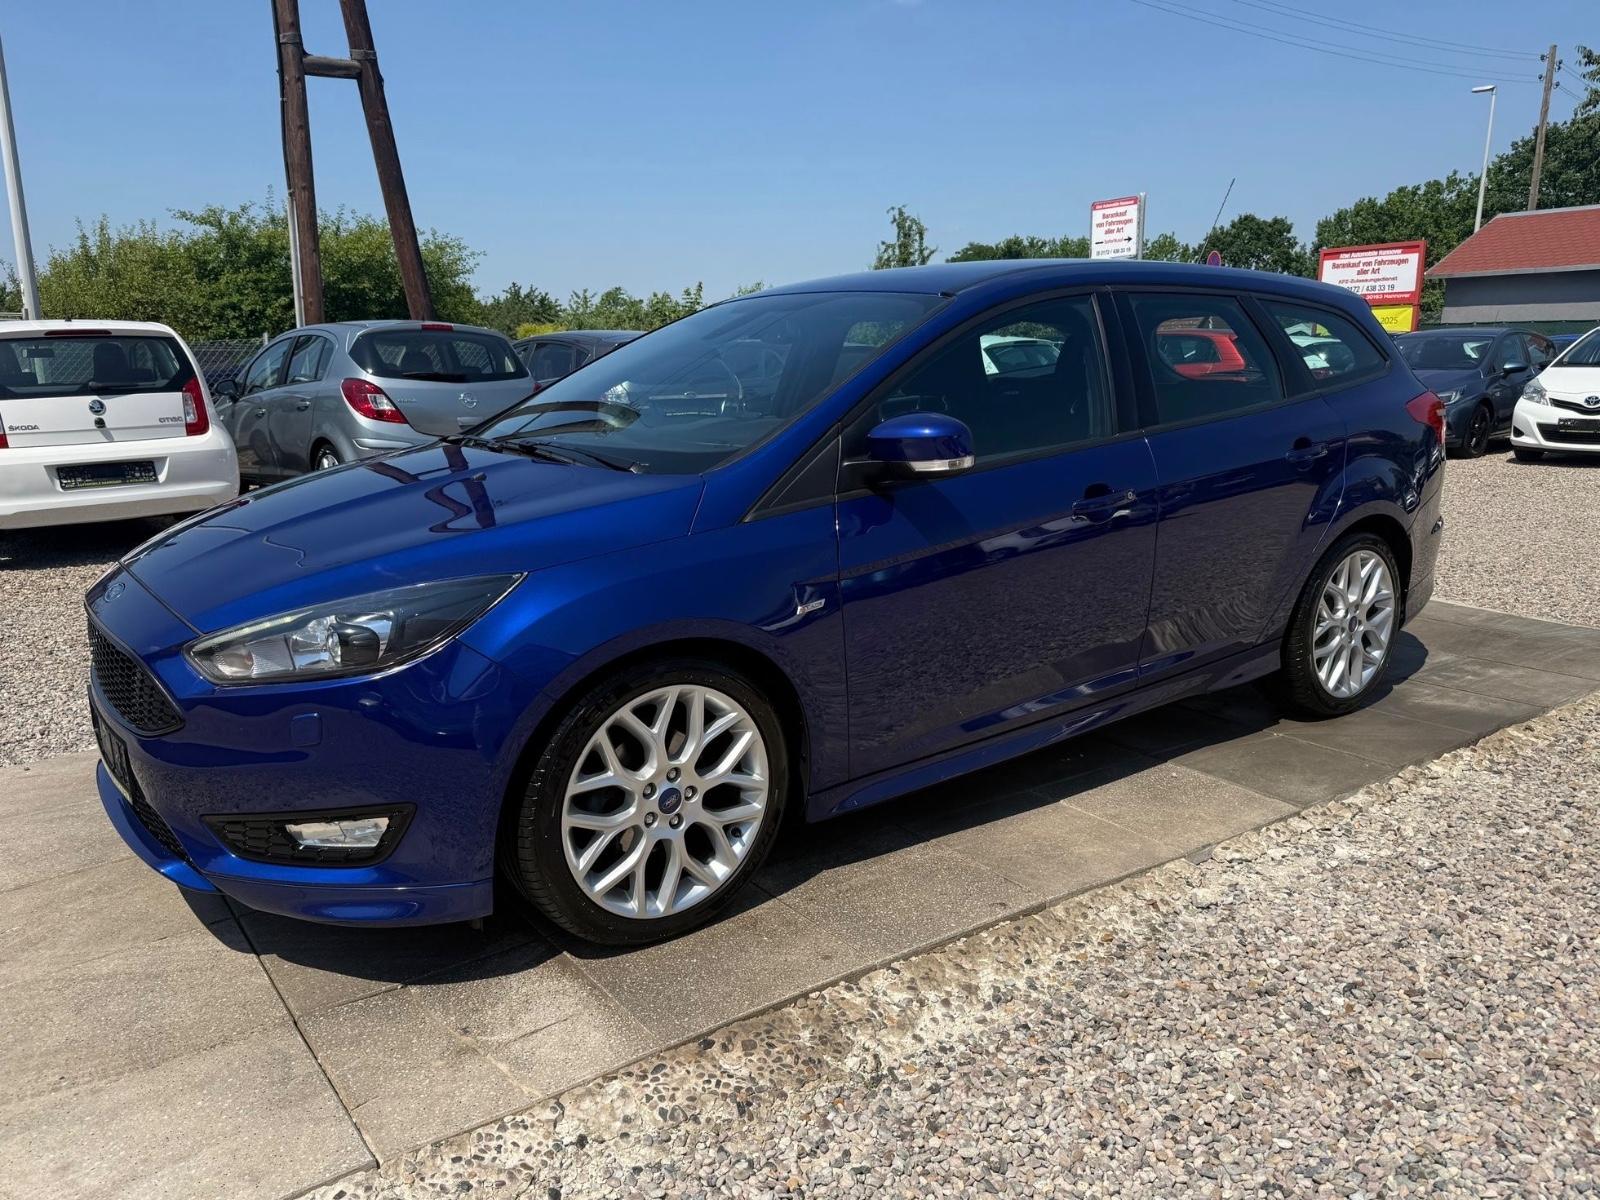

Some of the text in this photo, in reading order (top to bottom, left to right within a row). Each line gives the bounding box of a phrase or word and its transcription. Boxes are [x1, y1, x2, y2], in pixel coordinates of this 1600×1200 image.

[1105, 218, 1133, 227] Fahrzeugen
[1331, 260, 1361, 270] Barankauf
[1374, 258, 1409, 267] Fahrzeugen
[1381, 317, 1398, 325] 2025
